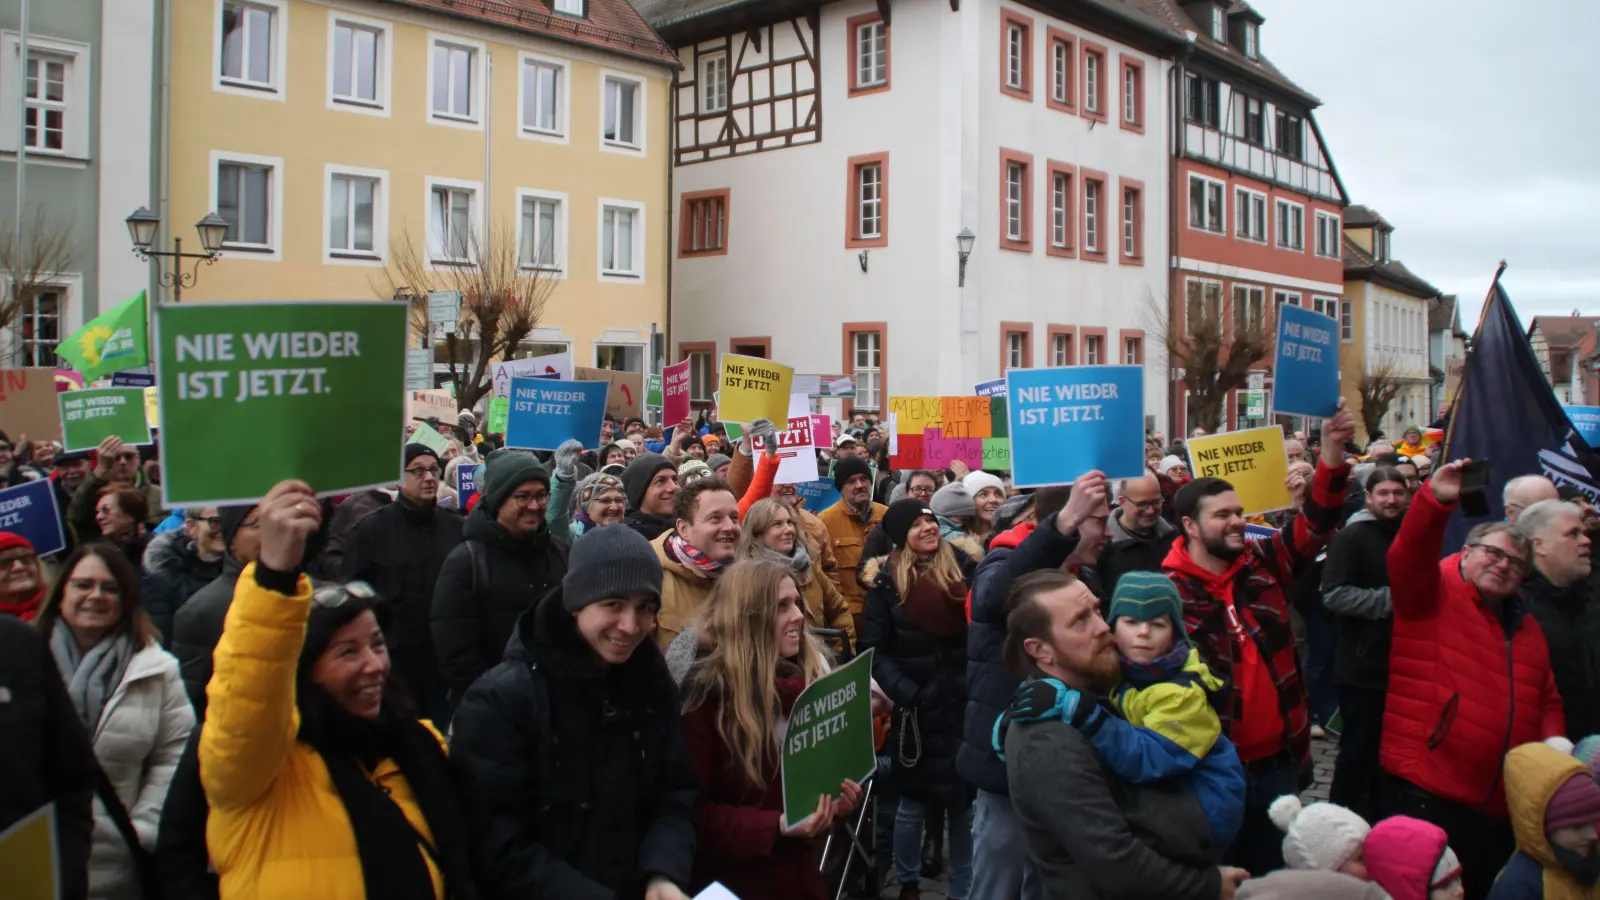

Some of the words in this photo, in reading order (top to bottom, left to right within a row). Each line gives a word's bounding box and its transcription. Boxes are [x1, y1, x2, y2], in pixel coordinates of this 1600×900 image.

[1284, 320, 1301, 338] NIE
[1302, 325, 1330, 345] WIEDER
[175, 333, 235, 362] NIE
[242, 331, 360, 360] WIEDER
[1282, 340, 1298, 357] IST
[1297, 344, 1323, 363] JETZT.
[666, 374, 678, 385] NIE
[726, 363, 745, 375] NIE
[747, 366, 781, 383] WIEDER
[177, 371, 229, 399] IST
[234, 367, 332, 403] JETZT.
[666, 386, 677, 397] IST
[725, 377, 742, 387] IST
[743, 379, 773, 393] JETZT.
[979, 387, 991, 396] NIE
[991, 384, 1006, 393] WIE
[1018, 385, 1052, 404] NIE
[1055, 383, 1119, 401] WIEDER
[64, 397, 85, 409] NIE
[85, 395, 126, 407] WIEDER
[515, 387, 537, 399] NIE
[540, 389, 586, 402] WIEDER
[66, 409, 83, 420] IST
[84, 406, 116, 420] JETZT.
[514, 401, 534, 412] IST
[534, 403, 572, 415] JETZT.
[1020, 407, 1048, 425] IST
[1052, 405, 1104, 427] JETZT.
[796, 419, 808, 428] ist
[925, 420, 972, 440] STATT
[953, 442, 1009, 460] Menschen
[1198, 447, 1220, 462] NIE
[1222, 440, 1265, 457] WIEDER
[461, 472, 473, 481] NI
[1201, 464, 1220, 478] IST
[1223, 458, 1257, 476] JETZT.
[462, 482, 474, 490] IST
[807, 482, 832, 490] WIEDER
[0, 495, 32, 513] EDER
[791, 703, 812, 731] NIE
[813, 680, 857, 717] WIEDER
[789, 728, 810, 755] IST
[811, 711, 849, 748] JETZT.
